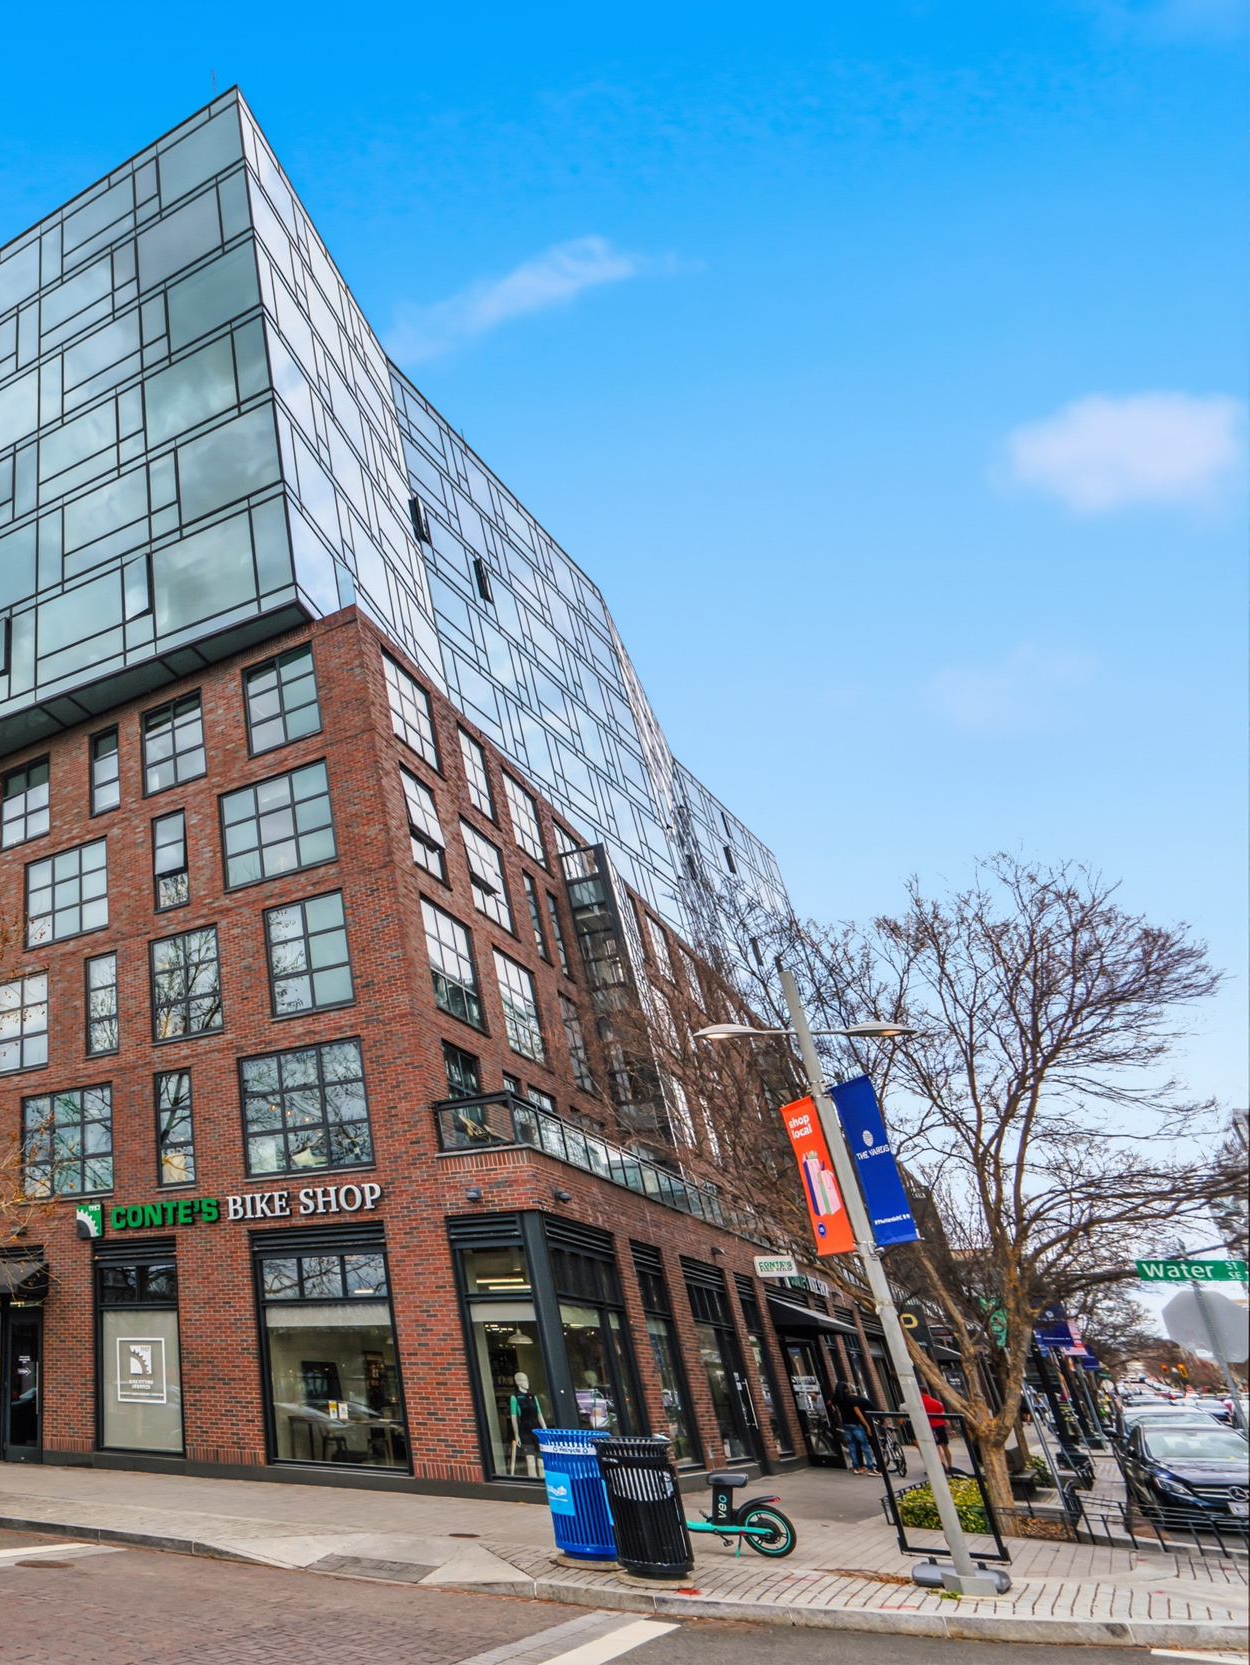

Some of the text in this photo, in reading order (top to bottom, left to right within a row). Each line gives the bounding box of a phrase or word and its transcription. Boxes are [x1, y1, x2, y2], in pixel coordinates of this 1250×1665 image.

[788, 1114, 810, 1129] shop
[791, 1123, 813, 1139] local
[856, 1151, 869, 1160] THE
[111, 1182, 382, 1229] CONTE'S BIKE SHOP
[1142, 1261, 1239, 1278] Water ST
[1227, 1271, 1244, 1280] SE
[718, 1494, 727, 1518] veo
